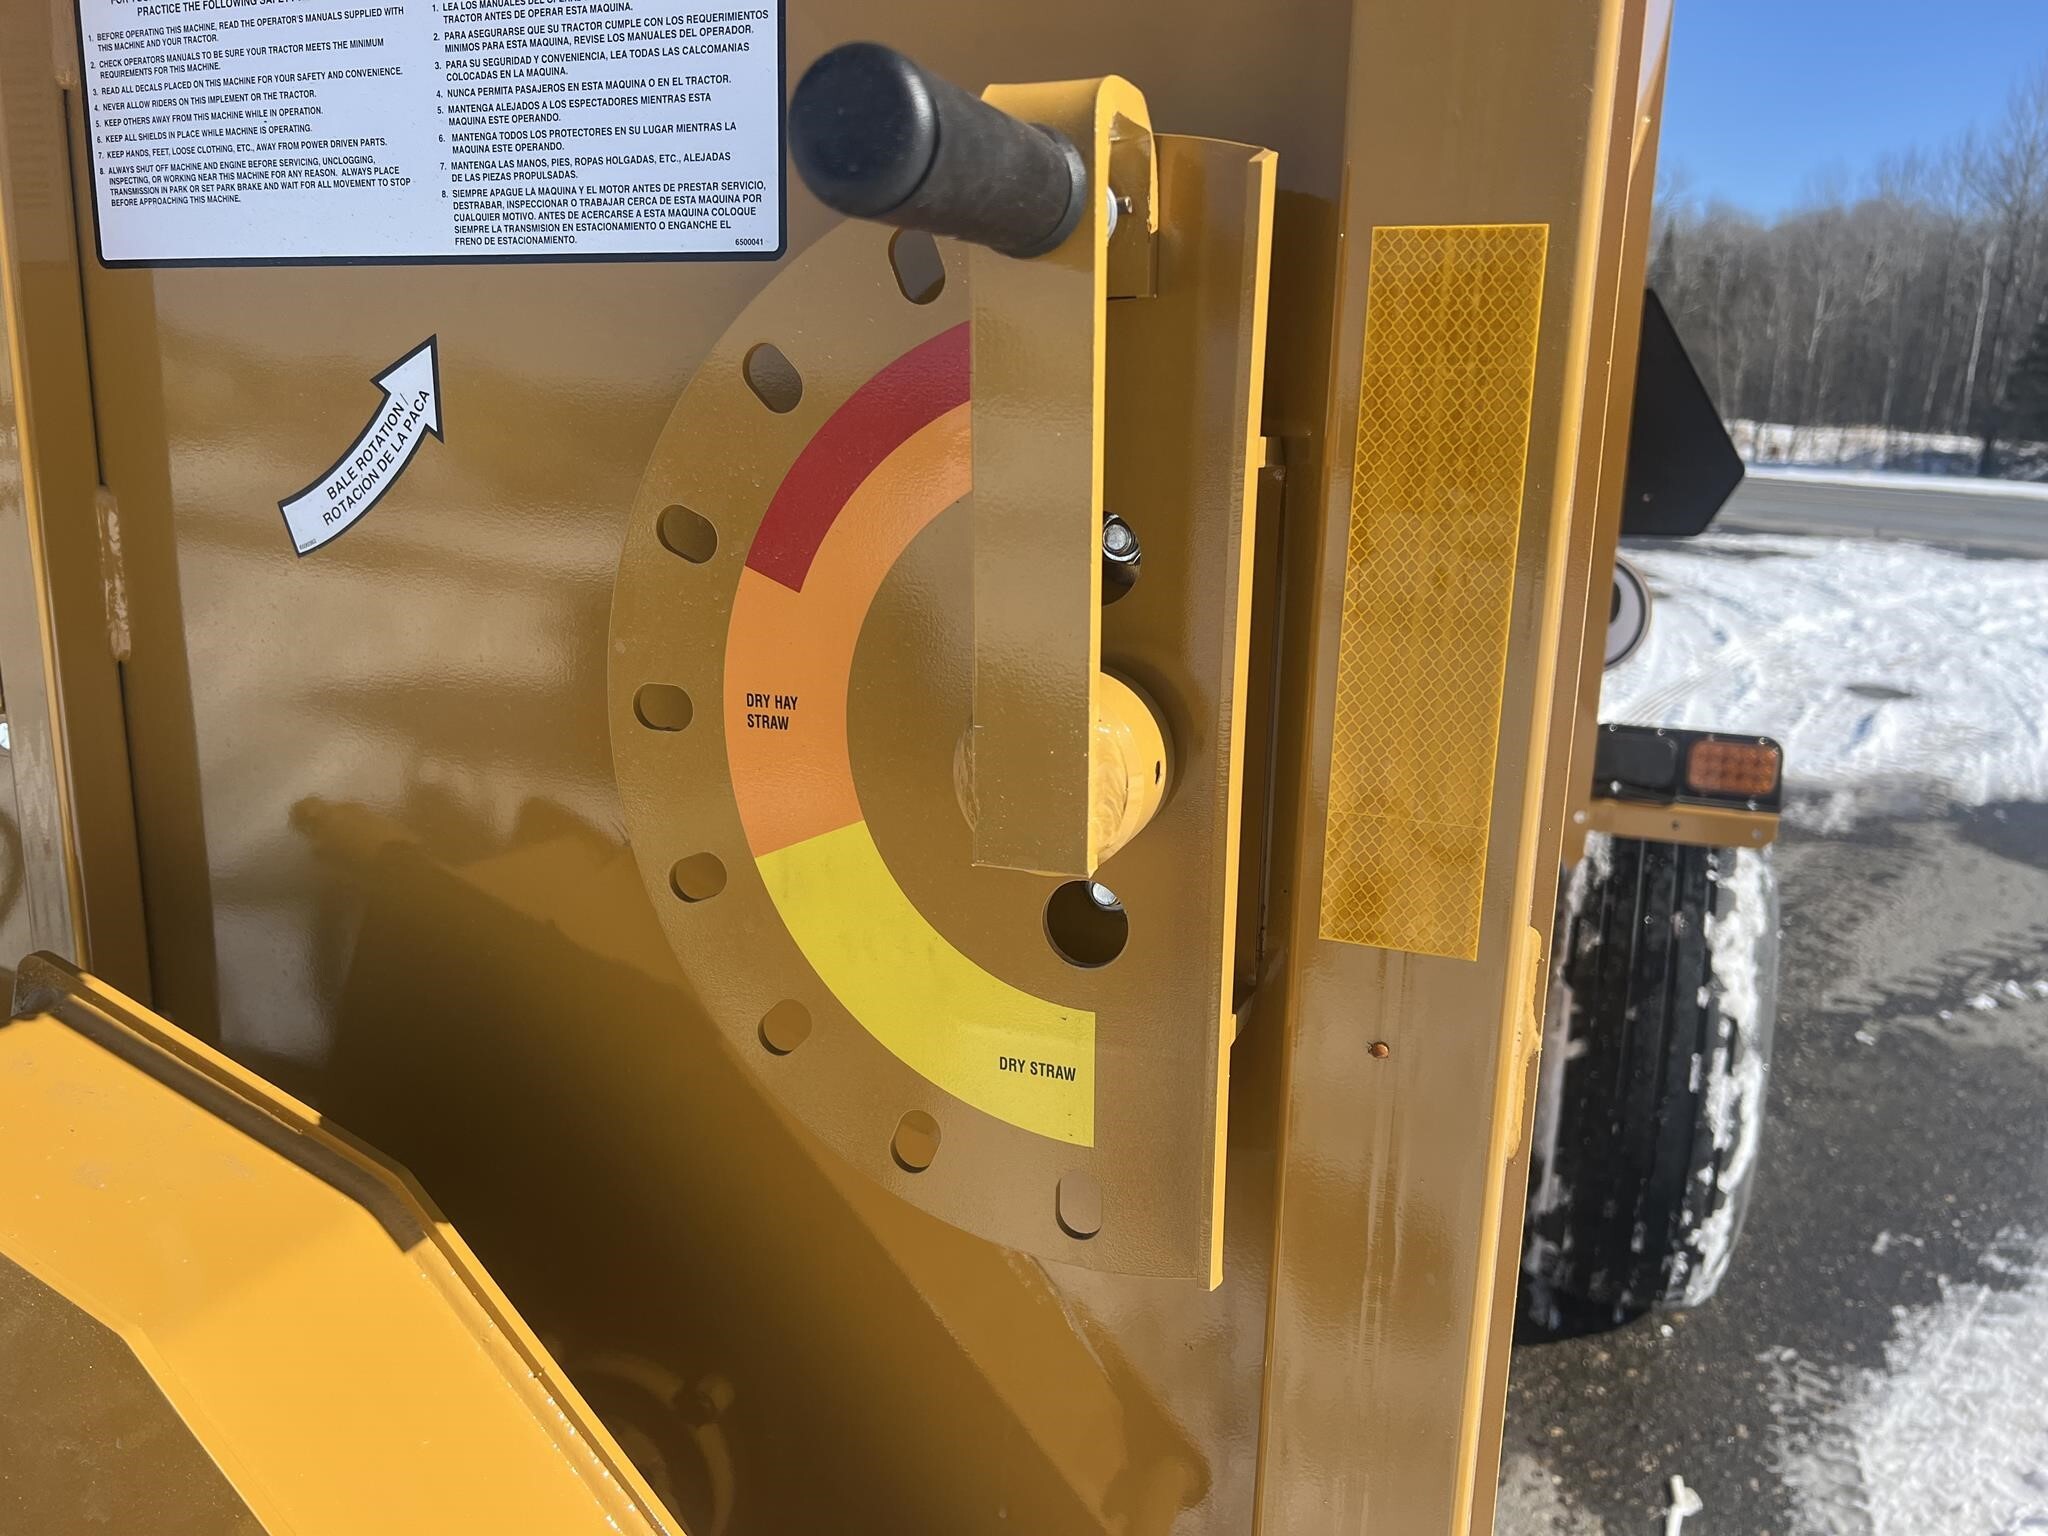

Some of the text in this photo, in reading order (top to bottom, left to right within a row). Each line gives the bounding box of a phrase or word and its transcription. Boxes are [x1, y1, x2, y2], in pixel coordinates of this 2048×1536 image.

[137, 0, 256, 16] PRACTICE THE FOLLOWING
[443, 2, 633, 23] TRACTOR ANTES DE OPERAR ESTA MAQUINA.
[434, 42, 749, 69] 3. PARA SU SEGURIDAD Y CONVENIENCIA, LEA TODAS LAS CALCOMANIAS
[101, 86, 119, 95] READ
[135, 83, 162, 92] DECALS
[163, 81, 191, 90] PLACED
[193, 80, 203, 88] ON
[205, 79, 221, 87] THIS
[222, 76, 255, 86] MACHINE
[257, 75, 272, 83] FOR
[274, 73, 294, 82] YOUR
[297, 71, 325, 81] SAFETY
[327, 70, 343, 79] AND
[345, 66, 403, 78] CONVENIENCE.
[446, 66, 568, 81] COLOCADAS EN LA MAQUINA.
[447, 88, 475, 97] NUNCA
[477, 86, 513, 95] PERMITA
[515, 83, 565, 93] PASAJEROS
[567, 82, 579, 91] EN
[581, 81, 603, 90] ESTA
[605, 79, 646, 89] MAQUINA
[648, 78, 655, 87] O
[657, 77, 669, 86] EN
[672, 77, 683, 85] EL
[685, 74, 731, 85] TRACTOR.
[102, 102, 124, 110] NEVER
[126, 100, 150, 109] ALLOW
[151, 98, 177, 107] RIDERS
[178, 97, 188, 105] ON
[190, 96, 206, 104] THIS
[207, 93, 248, 103] IMPLEMENT
[263, 92, 277, 100] THE
[279, 89, 317, 99] TRACTOR.
[437, 106, 444, 114] 5.
[448, 103, 493, 113] MANTENGA
[495, 101, 539, 111] ALEJADOS
[549, 100, 566, 108] LOS
[568, 96, 638, 107] ESPECTADORES
[640, 94, 685, 104] MIENTRAS
[688, 92, 711, 102] ESTA
[104, 118, 121, 126] KEEP
[123, 116, 150, 125] OTHERS
[152, 115, 170, 123] AWAY
[172, 114, 191, 122] FROM
[210, 110, 243, 120] MACHINE
[244, 109, 267, 118] WHILE
[278, 106, 323, 116] OPERATION.
[448, 113, 560, 125] MAQUINA ESTE OPERANDO.
[105, 134, 122, 142] KEEP
[138, 132, 166, 140] SHIELDS
[176, 130, 199, 138] PLACE
[201, 128, 223, 137] WHILE
[225, 126, 257, 135] MACHINE
[259, 126, 266, 134] IS
[268, 124, 312, 133] OPERATING.
[438, 122, 736, 142] 6. MANTENGA TODOS LOS PROTECTORES EN SU LUGAR MIENTRAS LA
[452, 142, 564, 153] MAQUINA ESTE OPERANDO.
[440, 152, 730, 170] 7. MANTENGA LAS MANOS, PIES, ROPAS HOLGADAS, ETC., ALEJADAS
[451, 170, 578, 182] DE LAS PIEZAS PROPULSADAS.
[452, 189, 487, 197] SIEMPRE
[490, 188, 523, 196] APAGUE
[538, 186, 576, 195] MAQUINA
[586, 186, 596, 194] EL
[599, 184, 629, 193] MOTOR
[632, 184, 660, 192] ANTES
[663, 183, 675, 191] DE
[677, 182, 718, 191] PRESTAR
[721, 181, 766, 190] SERVICIO,
[454, 220, 731, 233] SIEMPRE LA TRANSMISION EN ESTACIONAMIENTO O ENGANCHE EL
[454, 235, 577, 245] FRENO DE ESTACIONAMIENTO.
[377, 450, 395, 472] DE
[391, 432, 408, 453] LA
[403, 390, 429, 432] PACA
[326, 466, 358, 500] BALE
[356, 402, 404, 471] ROTATION
[746, 693, 798, 710] DRY HAY
[747, 714, 789, 730] STRAW
[1000, 1056, 1076, 1081] DRY STRAW
